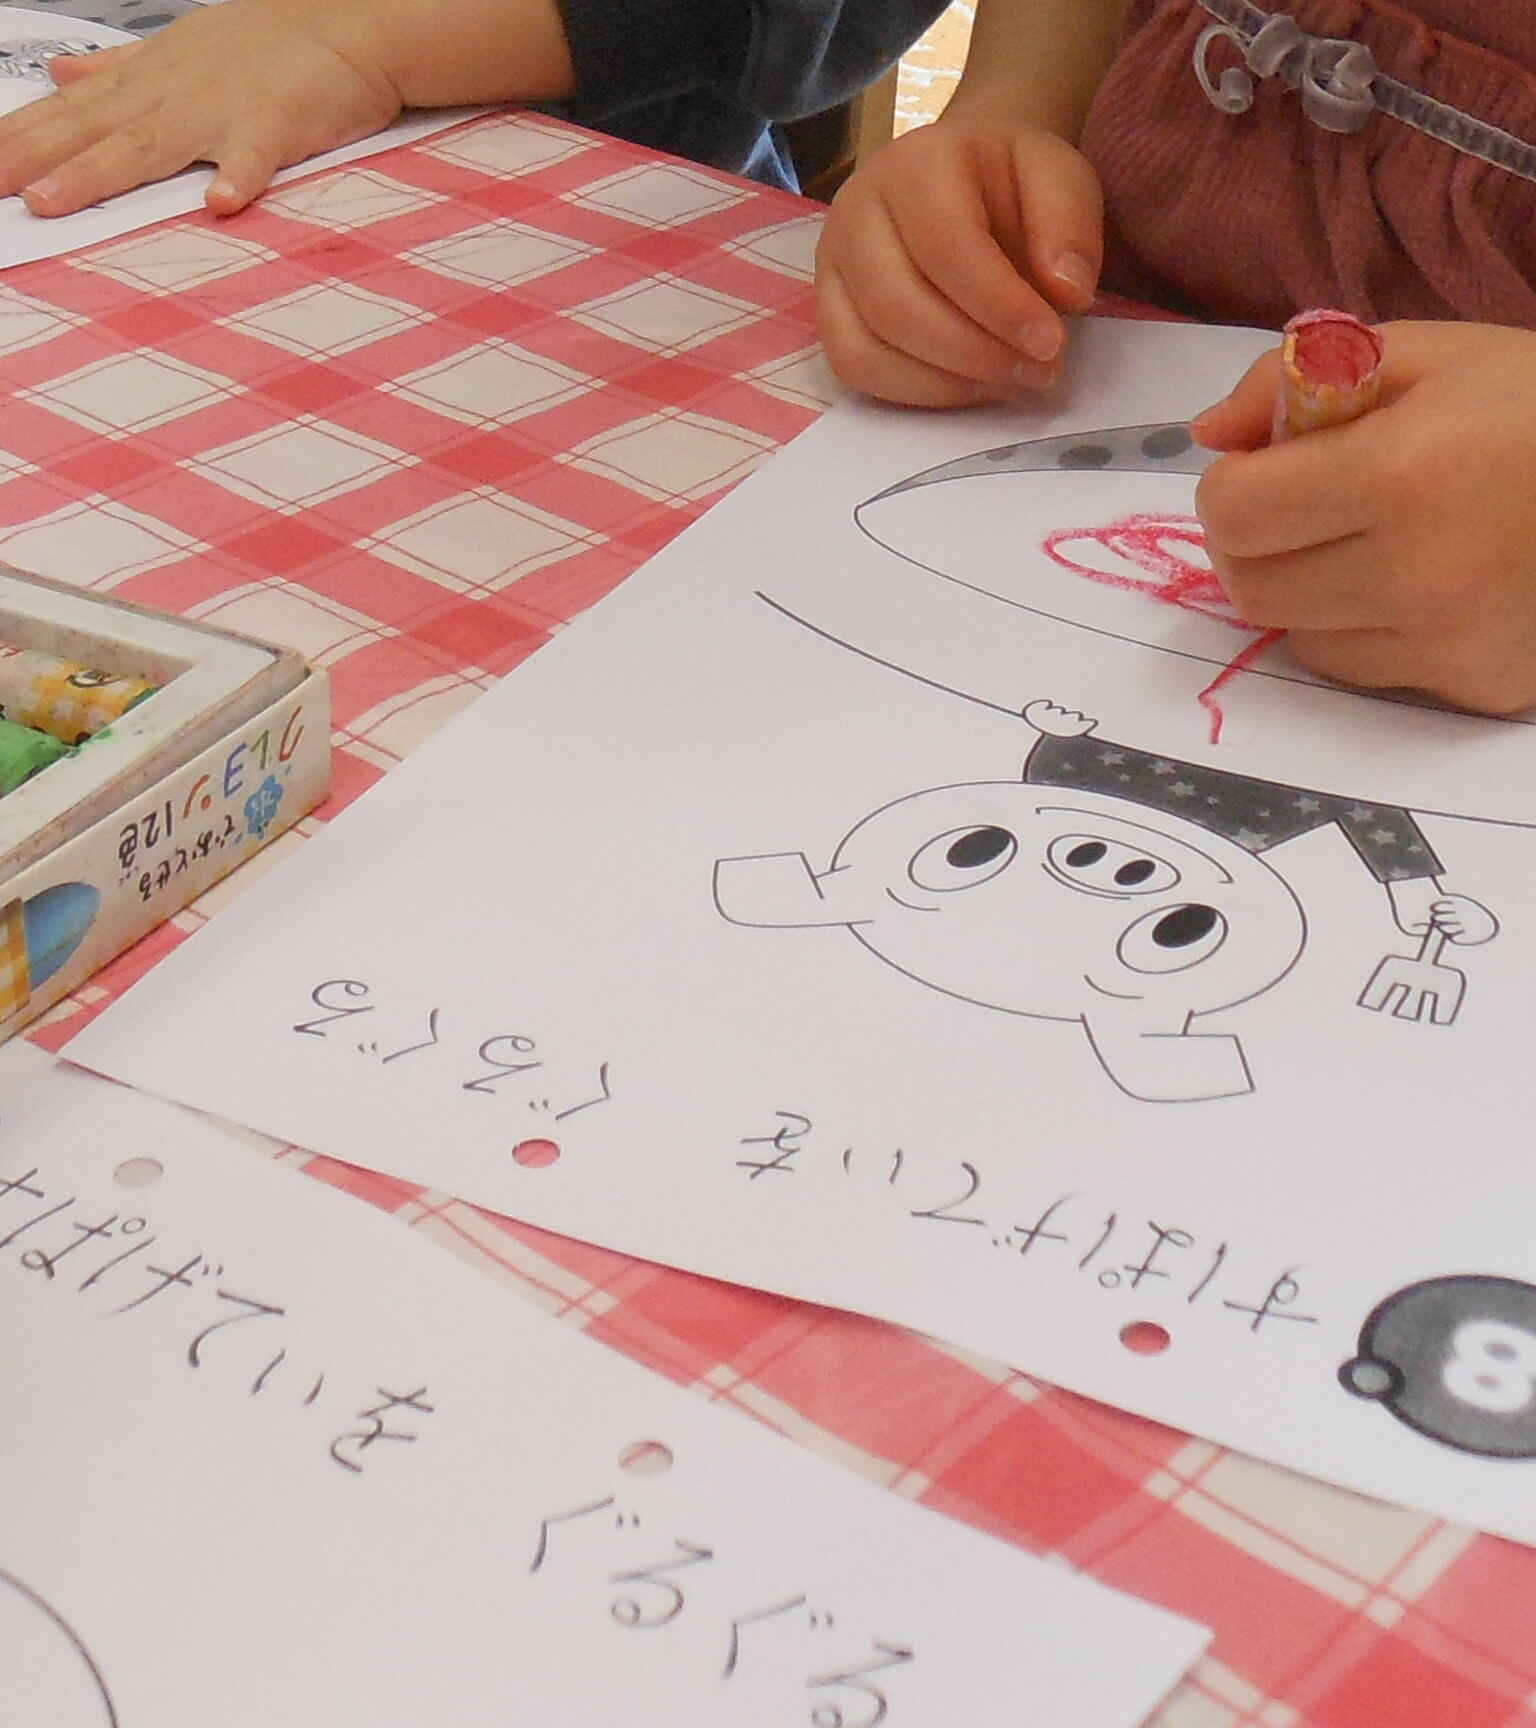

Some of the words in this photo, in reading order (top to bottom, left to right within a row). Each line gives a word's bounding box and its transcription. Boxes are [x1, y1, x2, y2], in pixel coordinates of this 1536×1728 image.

[118, 705, 305, 869] クレヨン12色
[293, 979, 611, 1121] ぐるぐる
[527, 1495, 916, 1728] ぐるぐる
